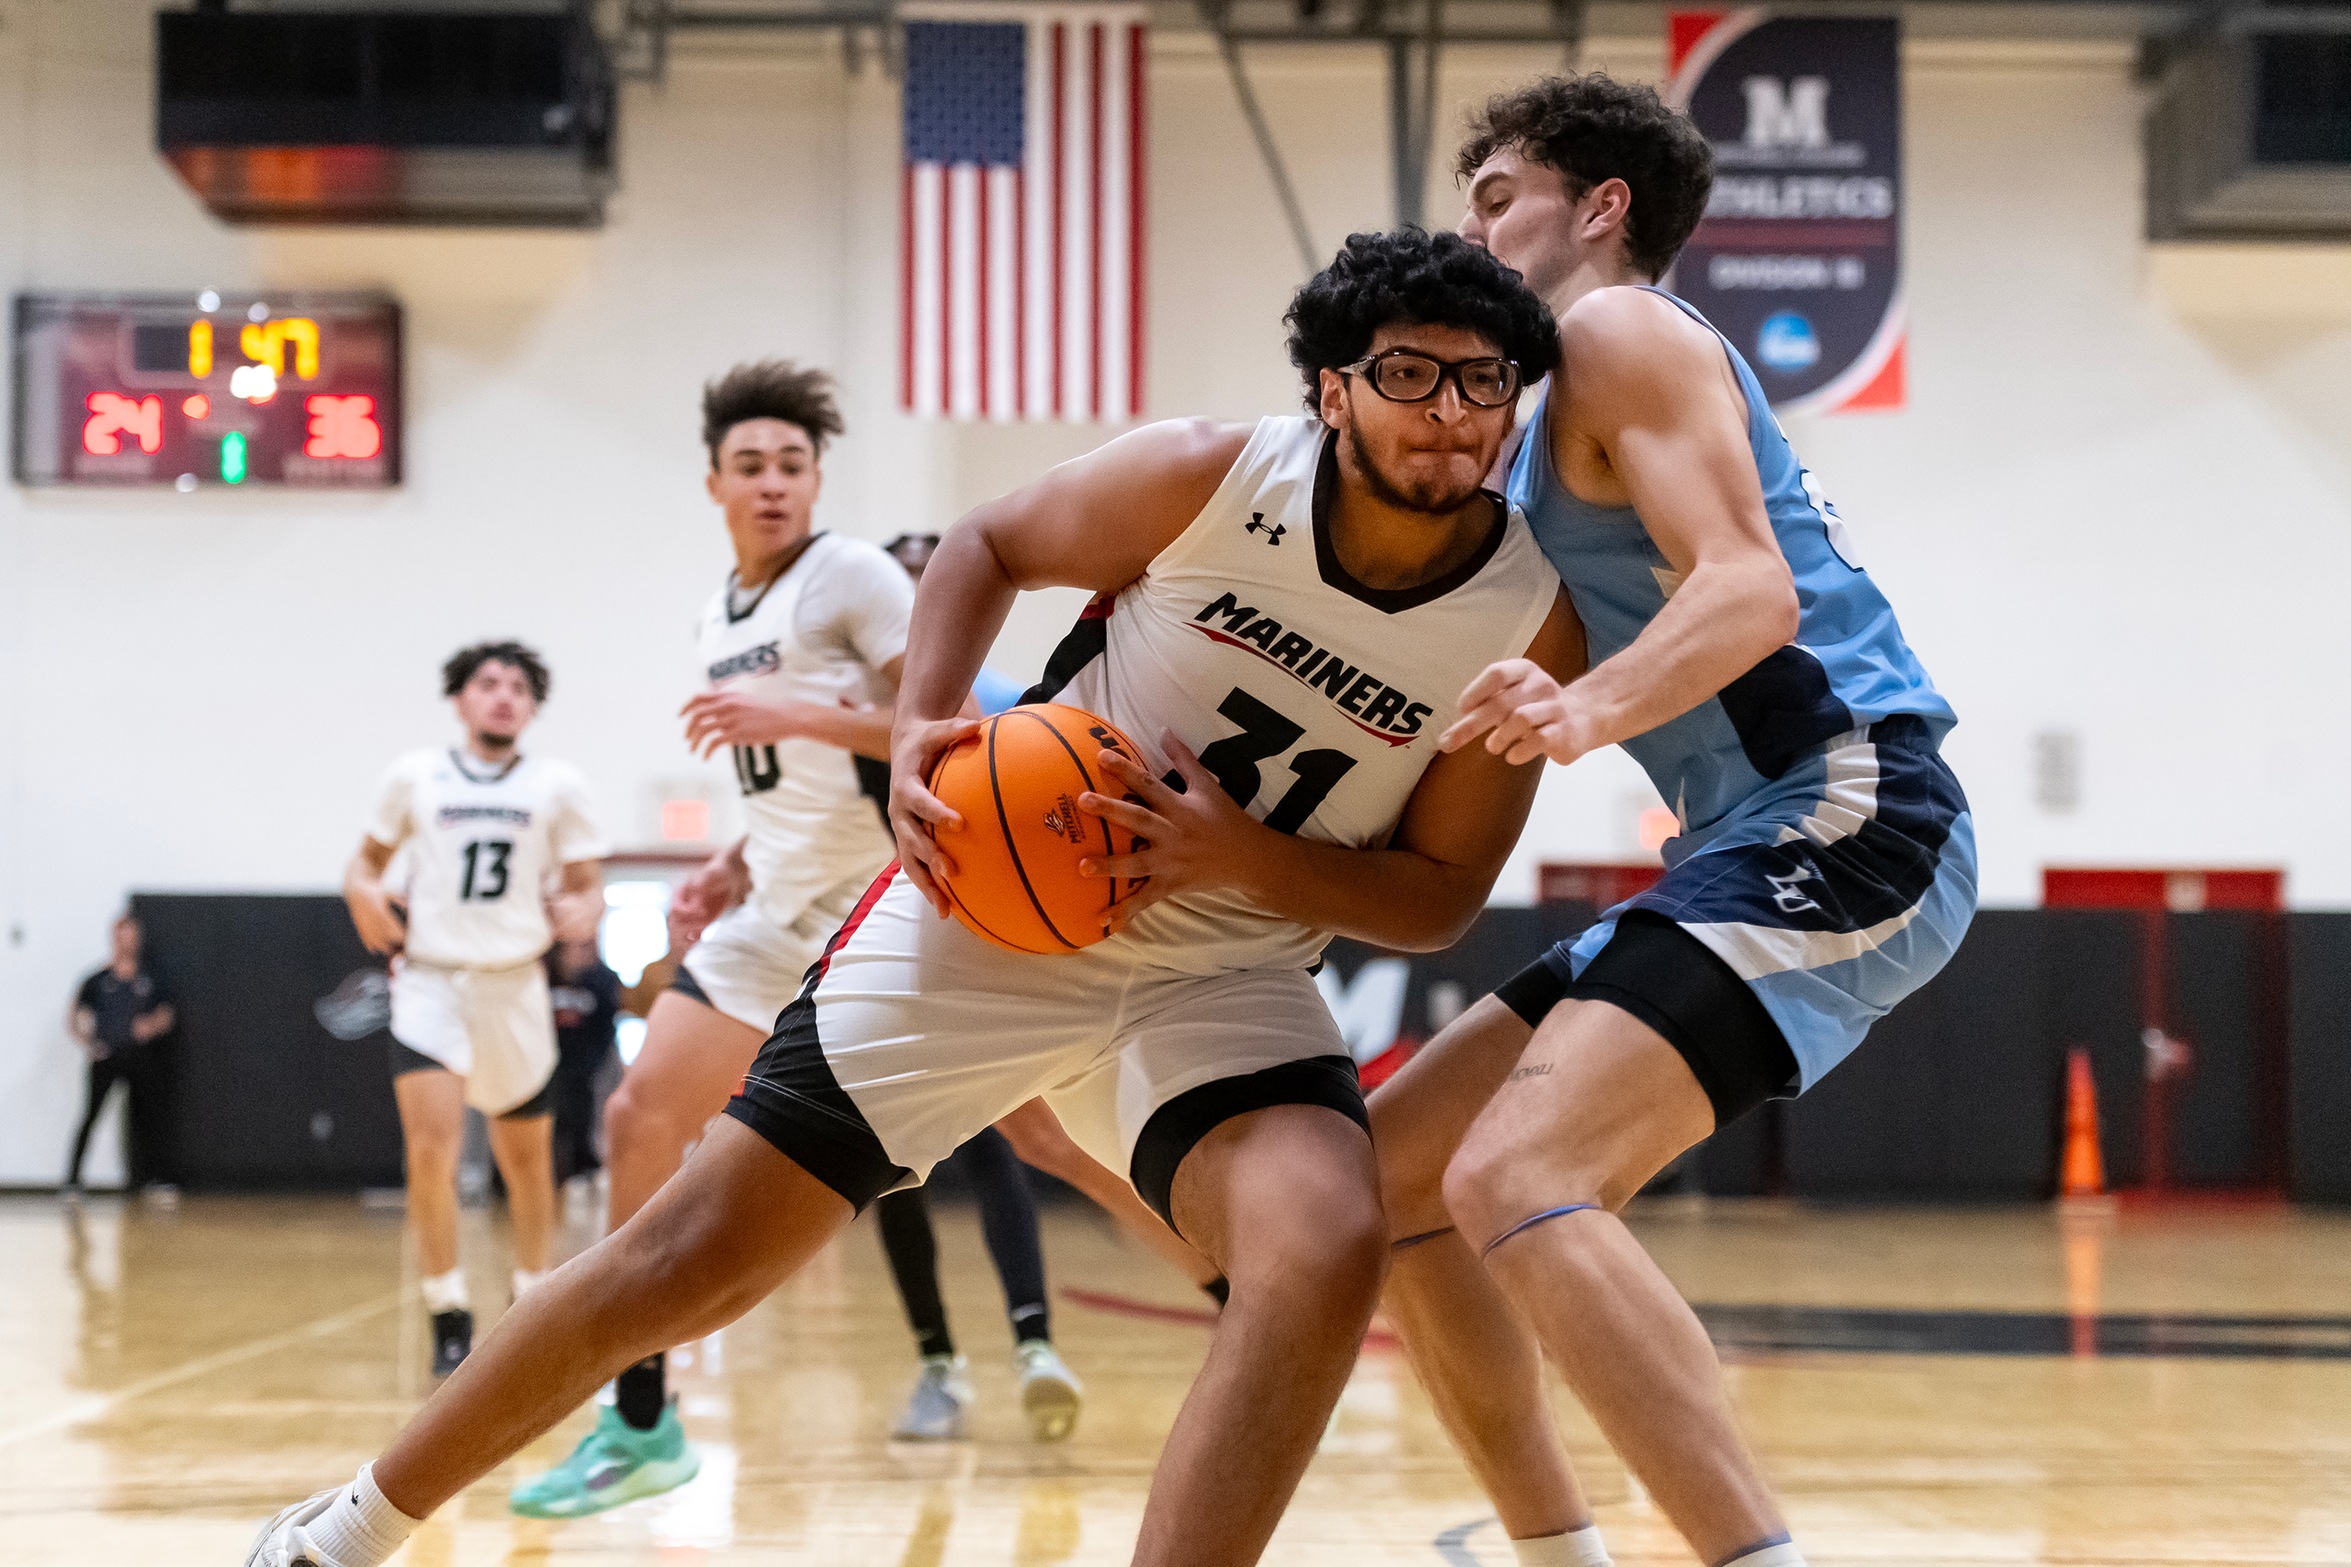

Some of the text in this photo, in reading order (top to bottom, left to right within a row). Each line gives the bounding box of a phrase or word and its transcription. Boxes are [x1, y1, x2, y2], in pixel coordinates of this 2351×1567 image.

[1742, 76, 1831, 146] M
[1706, 177, 1895, 219] THLETICS
[82, 391, 163, 455] 24
[1193, 591, 1434, 735] MARINERS
[1161, 686, 1359, 836] 31
[461, 840, 516, 901] 13
